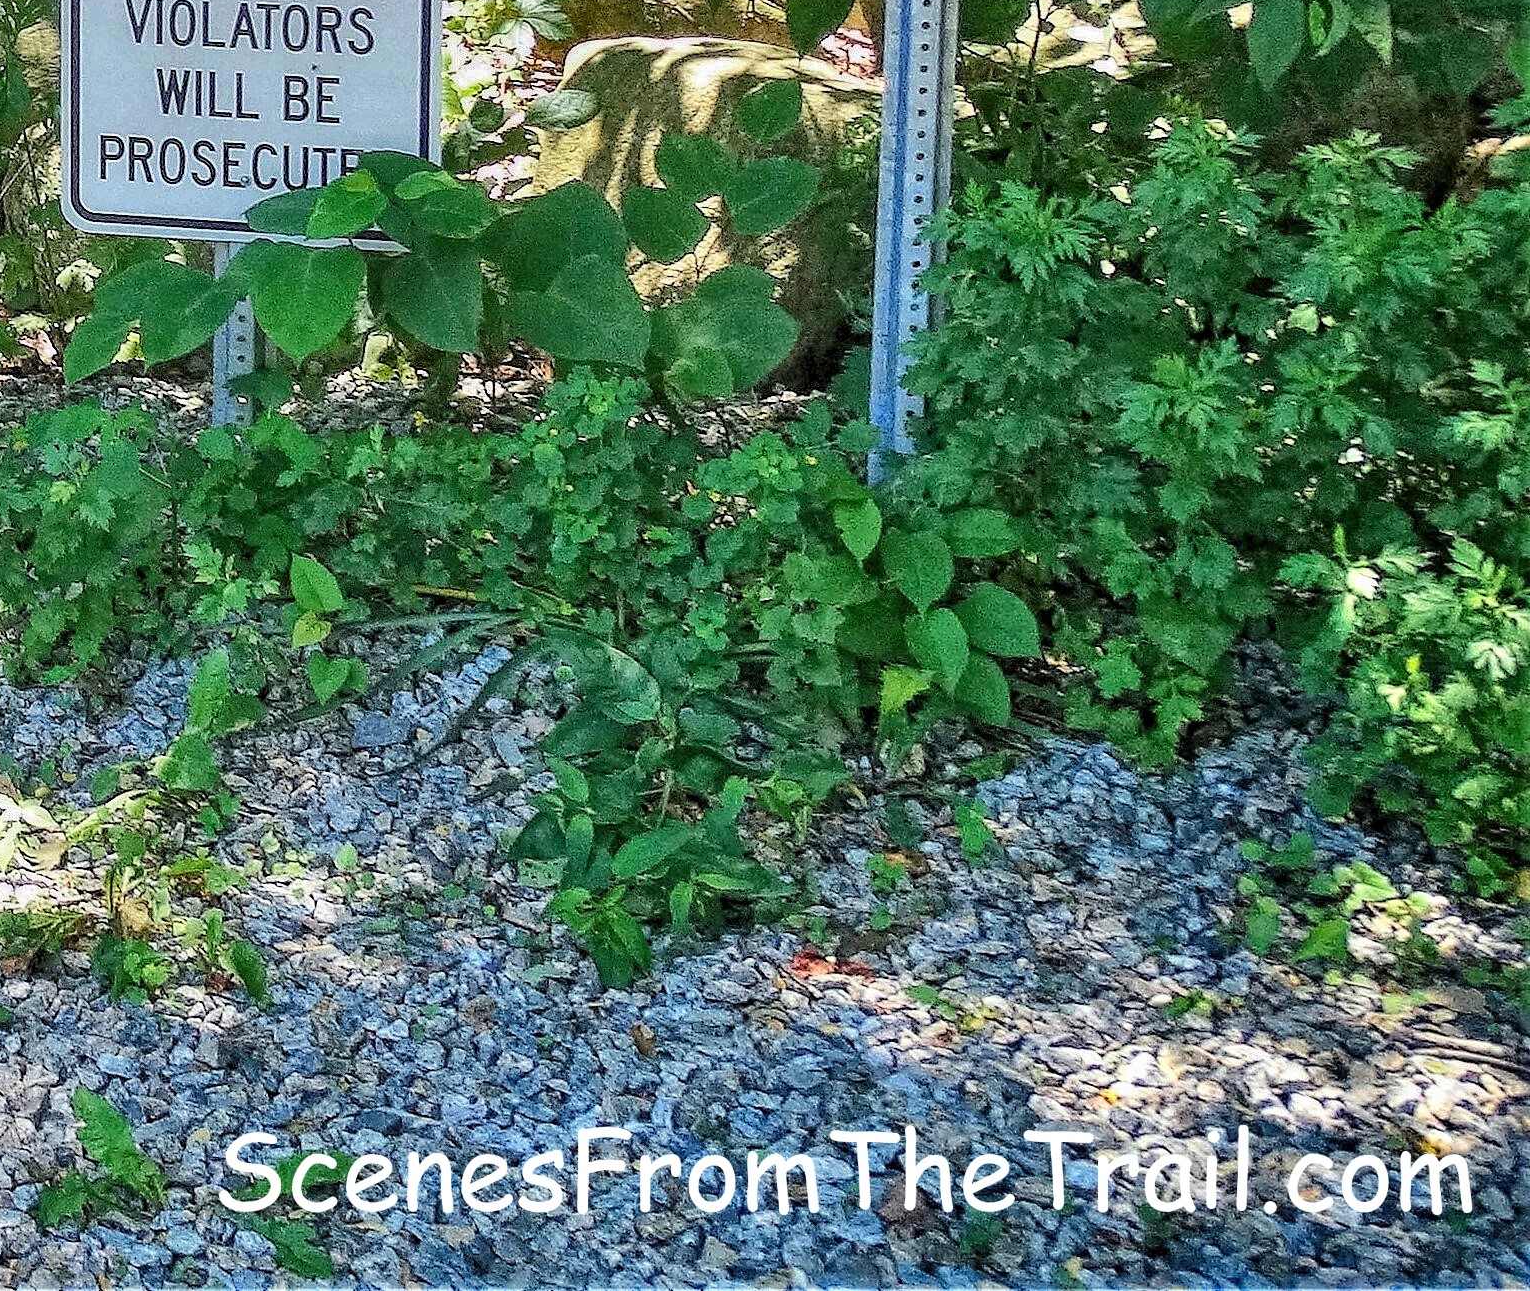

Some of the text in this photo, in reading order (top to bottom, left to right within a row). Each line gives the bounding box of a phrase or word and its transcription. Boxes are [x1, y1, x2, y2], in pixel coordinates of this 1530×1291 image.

[156, 68, 341, 125] WILL BE
[99, 134, 363, 190] PROSECUTE
